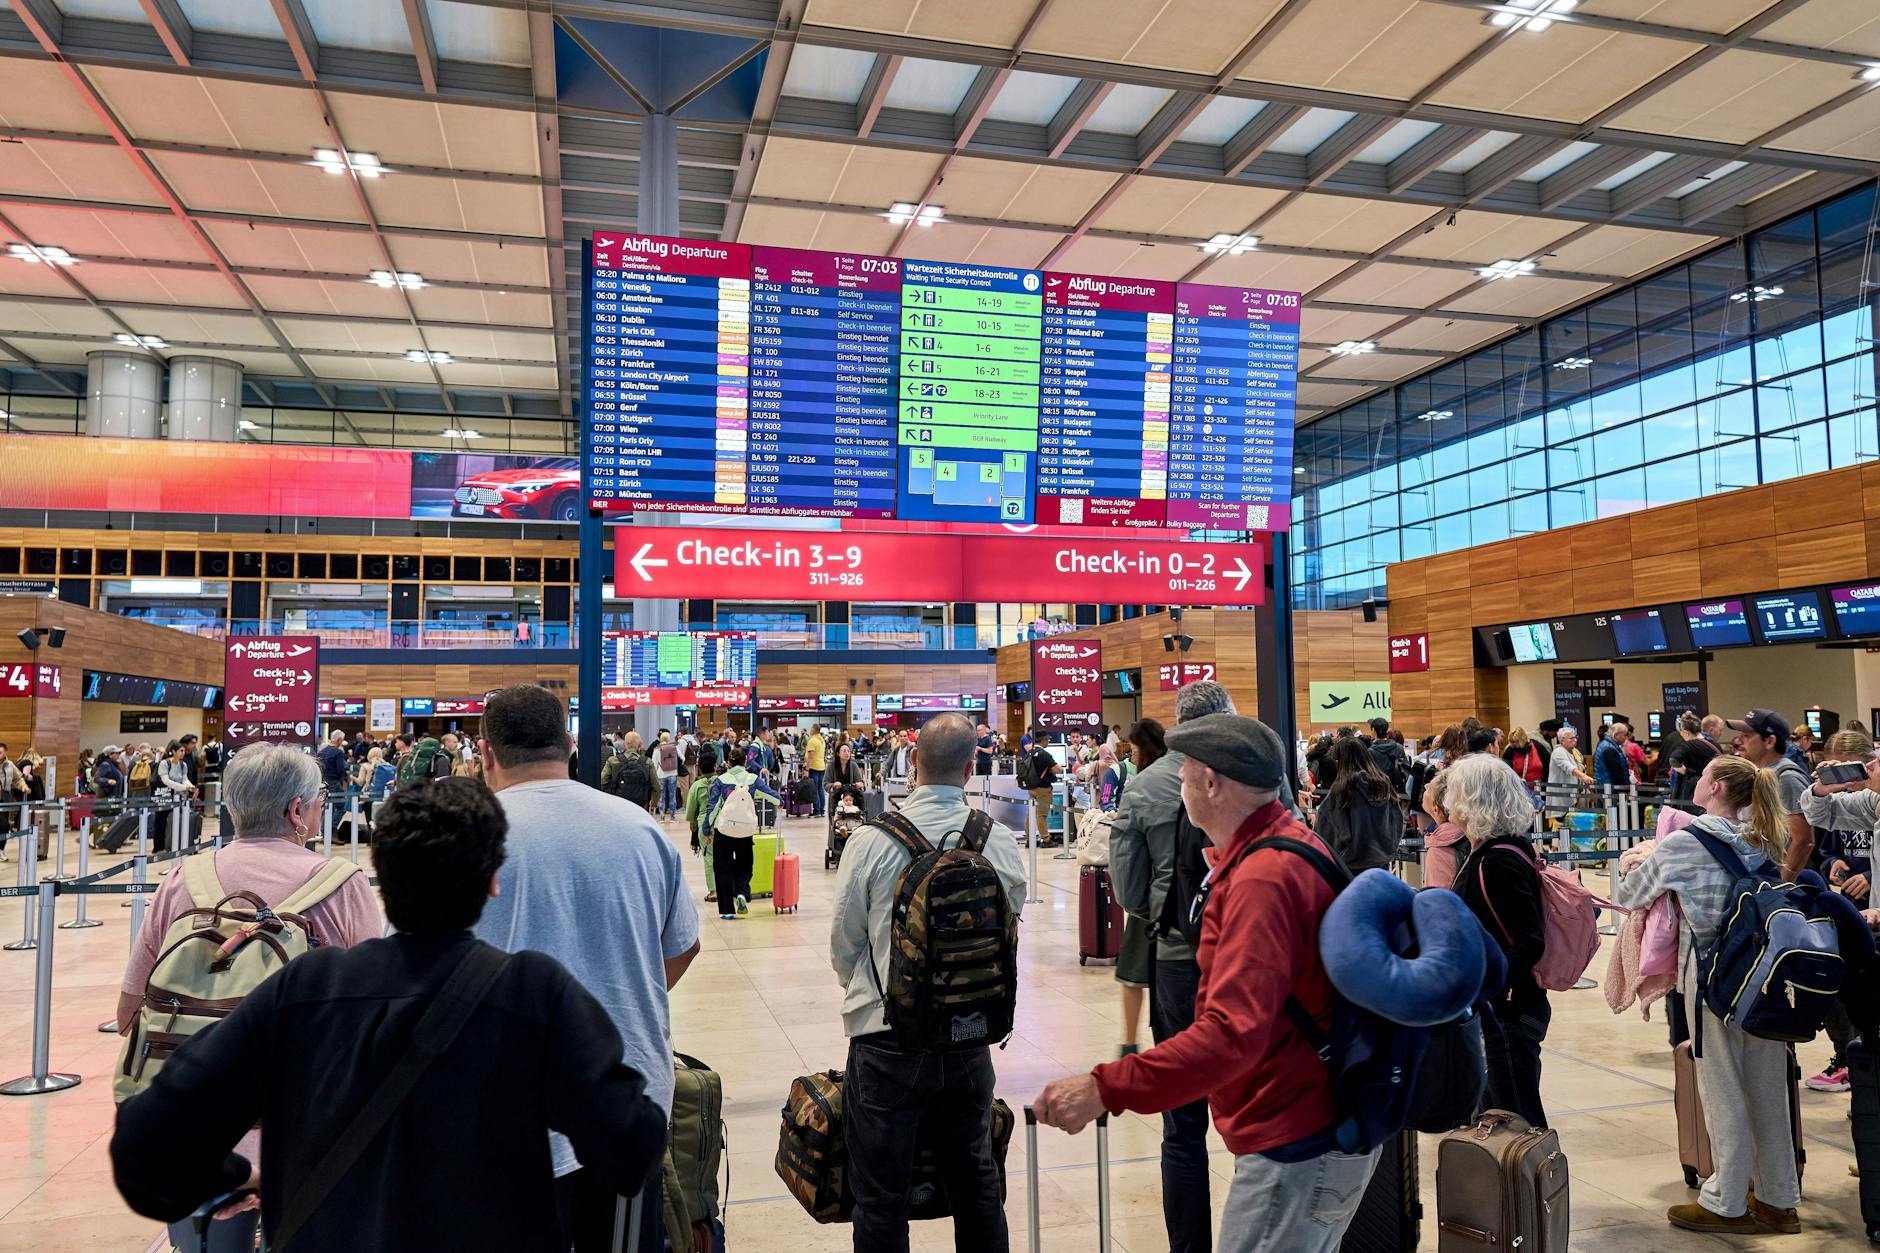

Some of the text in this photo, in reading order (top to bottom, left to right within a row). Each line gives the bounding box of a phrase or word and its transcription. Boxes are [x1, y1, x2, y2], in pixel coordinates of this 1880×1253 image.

[622, 238, 727, 259] Abflug Departure
[834, 257, 839, 268] 1
[861, 259, 897, 274] 07:03
[906, 264, 1018, 280] Wartezeit Sicherheitskontrolle
[622, 272, 644, 280] Palma
[656, 274, 686, 283] Mallorca
[906, 274, 928, 282] Waiting
[946, 277, 968, 285] Security
[1026, 278, 1036, 287] T1
[622, 283, 650, 292] Venedig
[1068, 278, 1155, 296] Abflug Departure
[791, 286, 819, 295] 011-012
[838, 290, 863, 299] Einstieg
[1242, 292, 1249, 303] 2
[622, 294, 662, 304] Amsterdam
[1267, 294, 1297, 307] 07:03
[791, 308, 819, 316] 811-816
[852, 312, 873, 320] Service
[977, 321, 1000, 330] 10-15
[976, 344, 990, 352] 1-6
[976, 367, 1000, 376] 16-21
[649, 372, 662, 381] City
[664, 373, 688, 382] Airport
[974, 390, 1000, 398] 18-23
[620, 414, 653, 423] Stuttgart
[919, 454, 924, 462] 5
[1013, 459, 1016, 467] 1
[943, 468, 949, 476] 4
[987, 469, 992, 477] 2
[647, 503, 665, 511] jeder
[667, 503, 732, 512] Sicherheitskontrolle
[750, 507, 780, 515] sämtliche
[781, 508, 820, 516] Abfluggates
[1125, 519, 1157, 527] Großgepäck
[677, 541, 861, 567] Check-in 3–9
[1055, 550, 1215, 575] Check-in 0–2
[809, 573, 863, 585] 311–926
[1169, 579, 1215, 591] 011–226
[1850, 588, 1873, 597] QATAR
[1595, 617, 1606, 626] 125
[248, 641, 280, 653] Abflug
[1050, 644, 1075, 653] Abflug
[1392, 636, 1426, 663] Check-in 1
[248, 651, 285, 659] Departure
[254, 668, 295, 677] Check-in
[1173, 665, 1178, 685] 2
[1202, 665, 1214, 681] 2
[9, 666, 29, 690] 4
[53, 668, 60, 692] 4
[1676, 687, 1686, 695] Bag
[1686, 686, 1699, 695] Drop
[246, 694, 288, 702] Check-in
[246, 704, 265, 712] 3–9
